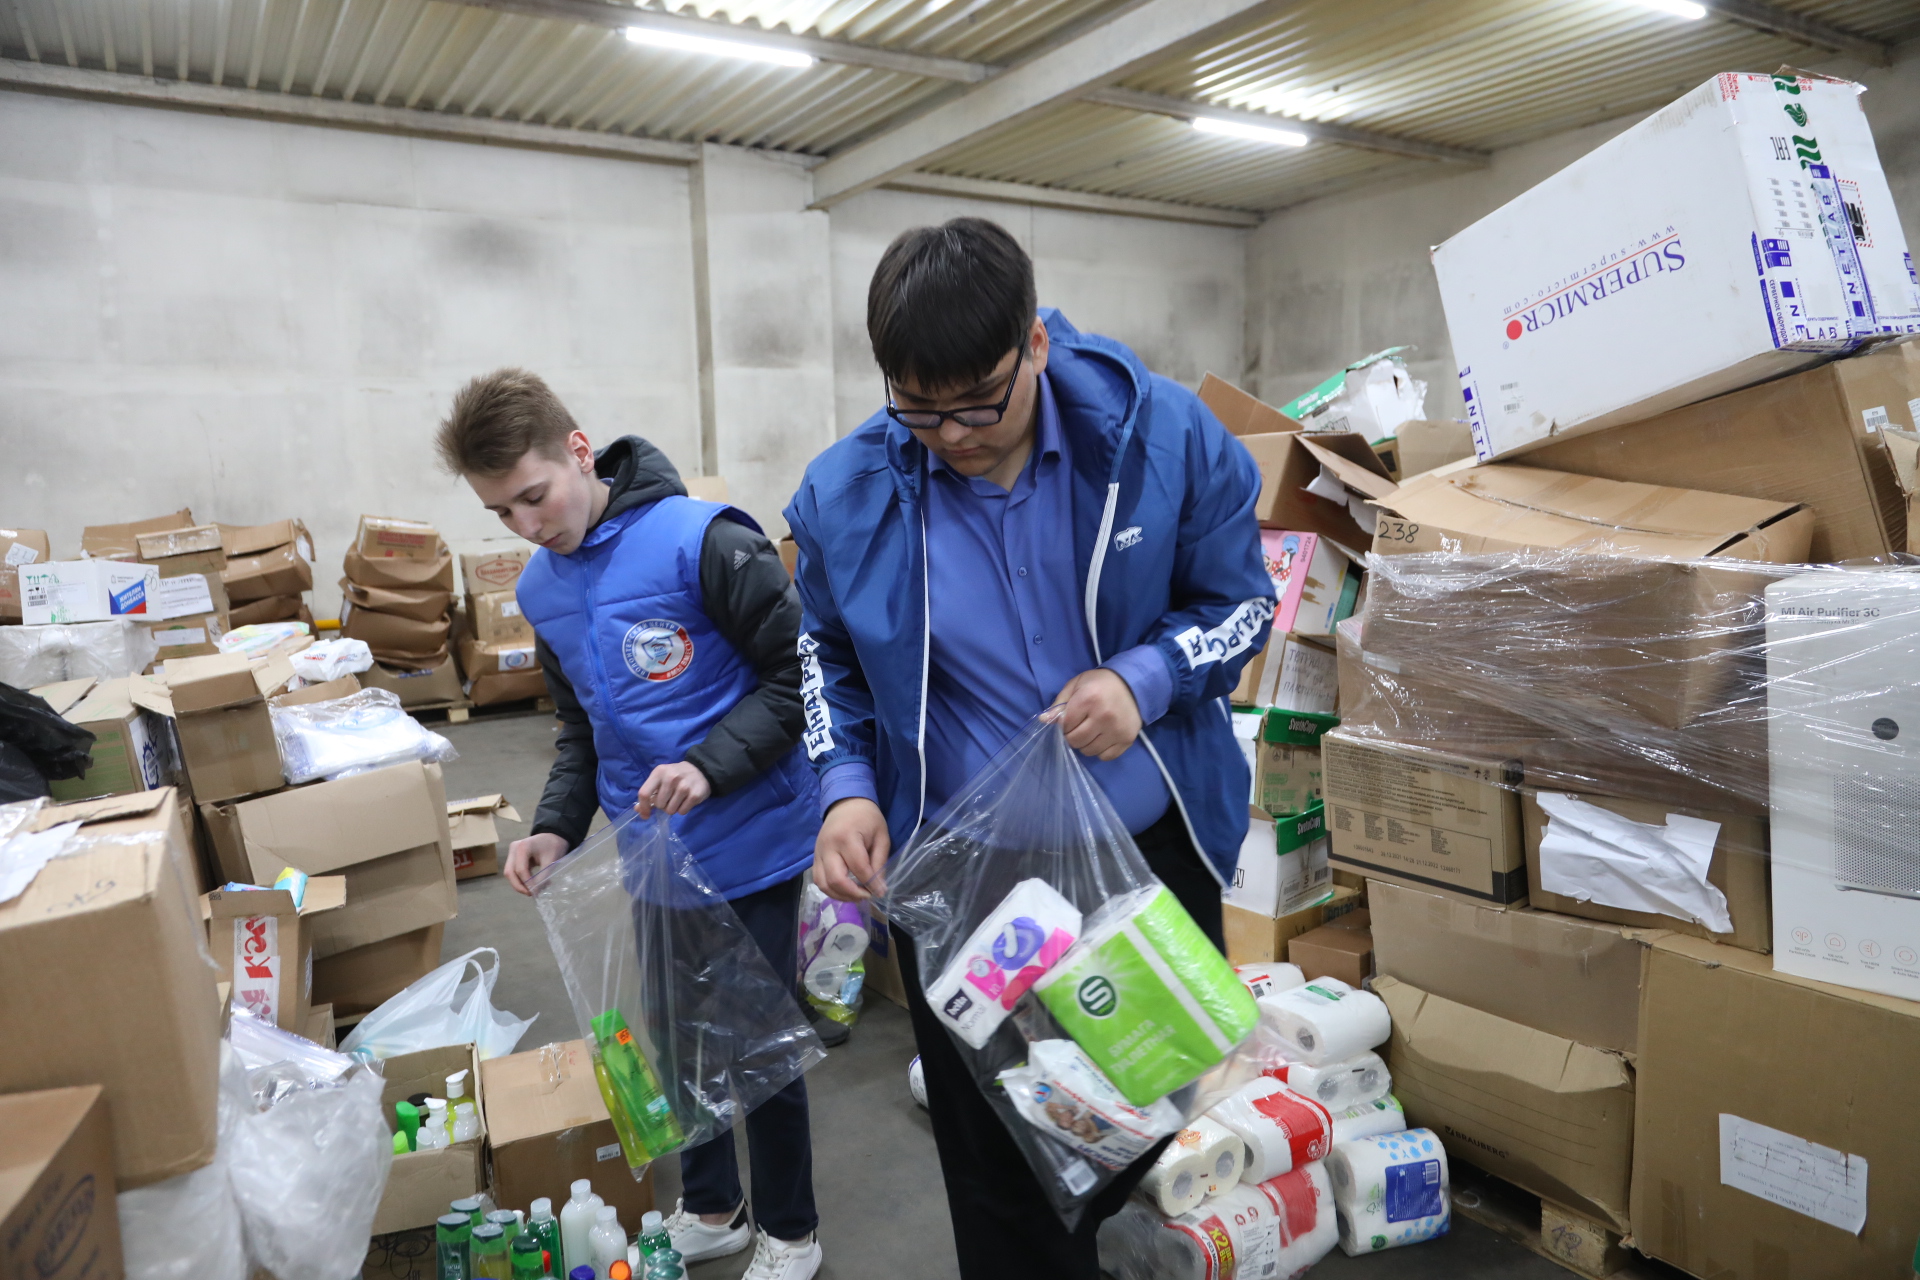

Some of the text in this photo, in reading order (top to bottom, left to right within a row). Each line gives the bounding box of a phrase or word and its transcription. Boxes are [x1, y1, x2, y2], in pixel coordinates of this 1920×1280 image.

[1378, 520, 1419, 543] 238
[1781, 607, 1880, 618] Mi Air Purifier 3C
[1289, 717, 1318, 735] SvetoCopy
[1454, 1131, 1506, 1159] BRAUBERG
[1764, 1190, 1810, 1213] PACKING LIST
